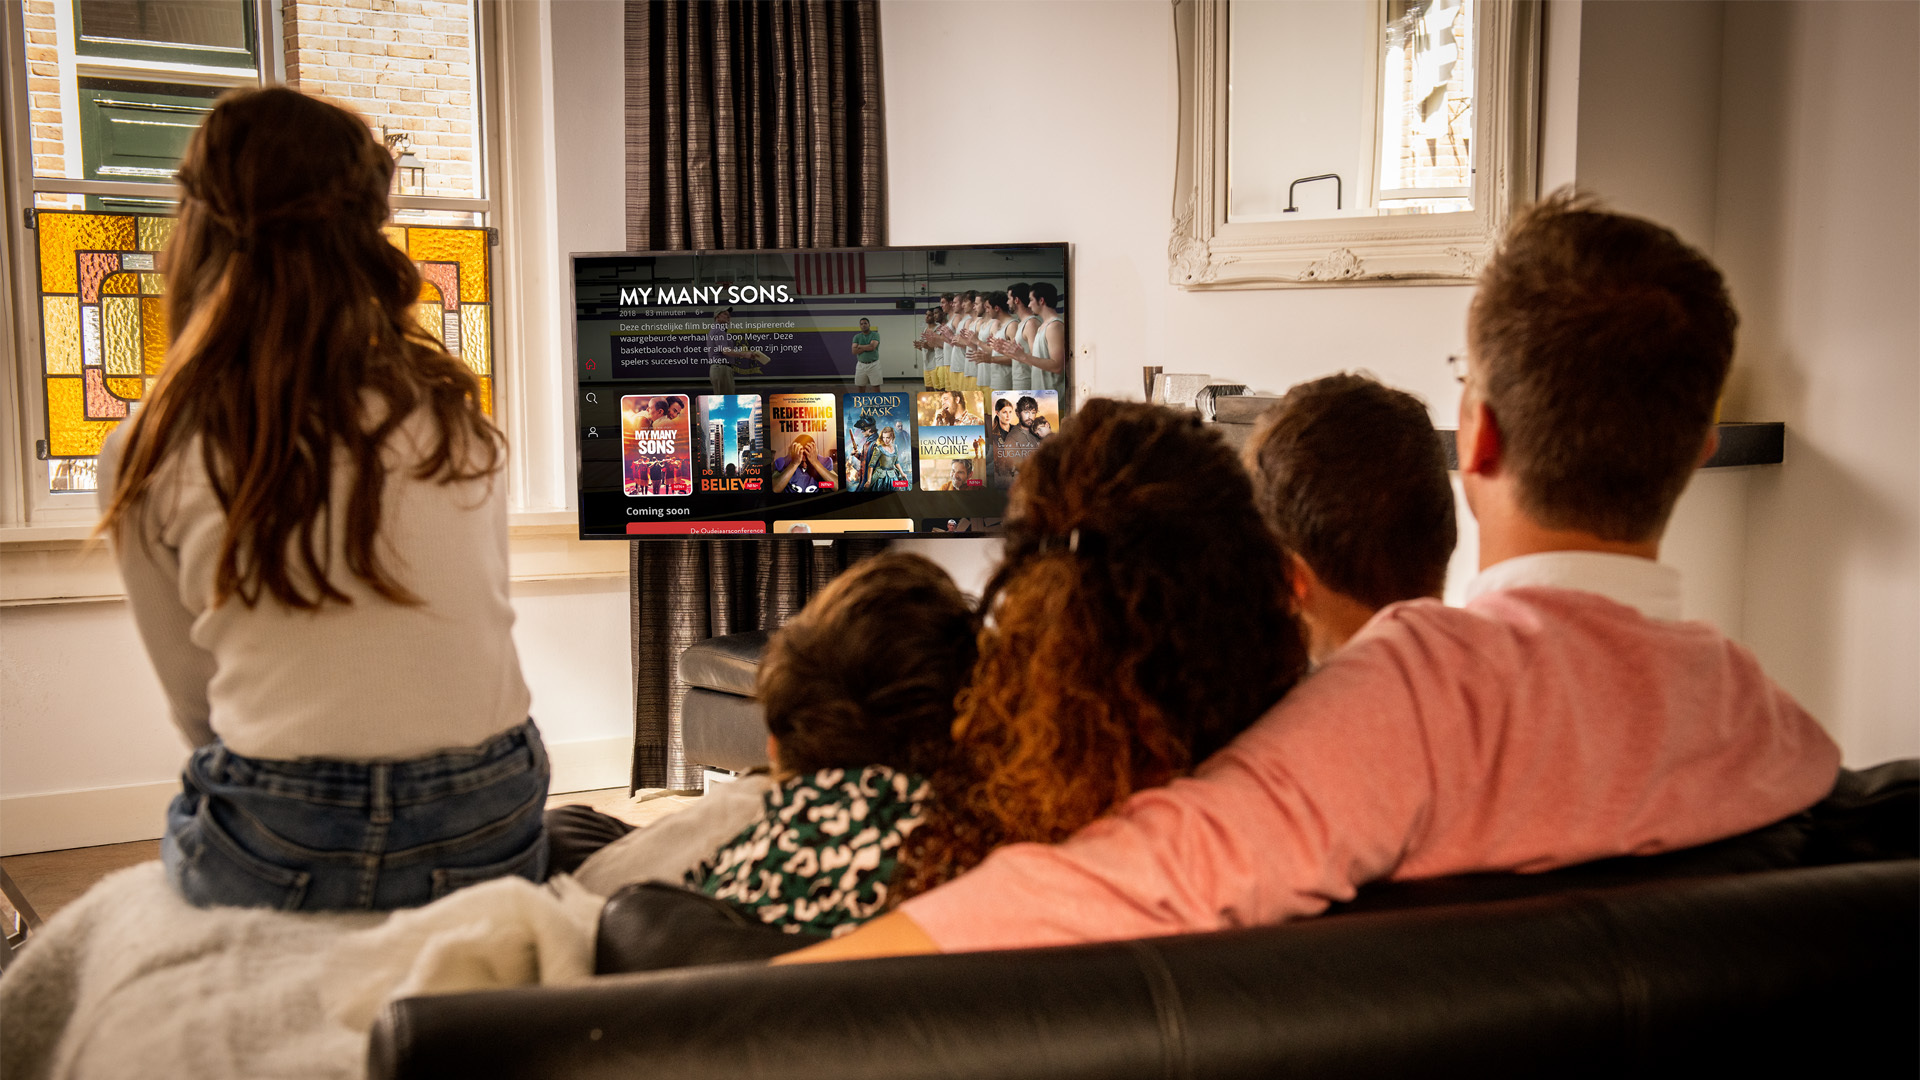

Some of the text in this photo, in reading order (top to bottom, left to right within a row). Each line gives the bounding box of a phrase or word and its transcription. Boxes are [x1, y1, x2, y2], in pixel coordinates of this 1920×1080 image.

[620, 284, 794, 306] MY MANY SONS.
[620, 320, 795, 332] Deze christelijke film brengt het inspirerende
[620, 334, 676, 344] waargebeurde
[678, 333, 708, 342] verhaal
[726, 333, 742, 341] Don
[745, 332, 772, 342] Meyer.
[774, 332, 794, 340] Deze
[620, 346, 681, 354] basketbalcoach
[684, 345, 701, 353] doet
[714, 344, 732, 352] alles
[765, 344, 778, 354] zijn
[780, 344, 802, 354] jonge
[621, 358, 649, 367] spelers
[651, 357, 688, 365] succesvol
[700, 356, 730, 364] maken.
[852, 396, 900, 408] BEYOND
[772, 406, 832, 419] REDEEMING
[860, 407, 893, 416] MASK
[779, 420, 828, 432] THE TIME
[635, 430, 677, 440] MY MANY
[937, 436, 968, 445] ONLY
[638, 440, 675, 454] SONS
[920, 445, 969, 455] IMAGINE
[626, 507, 664, 517] Coming
